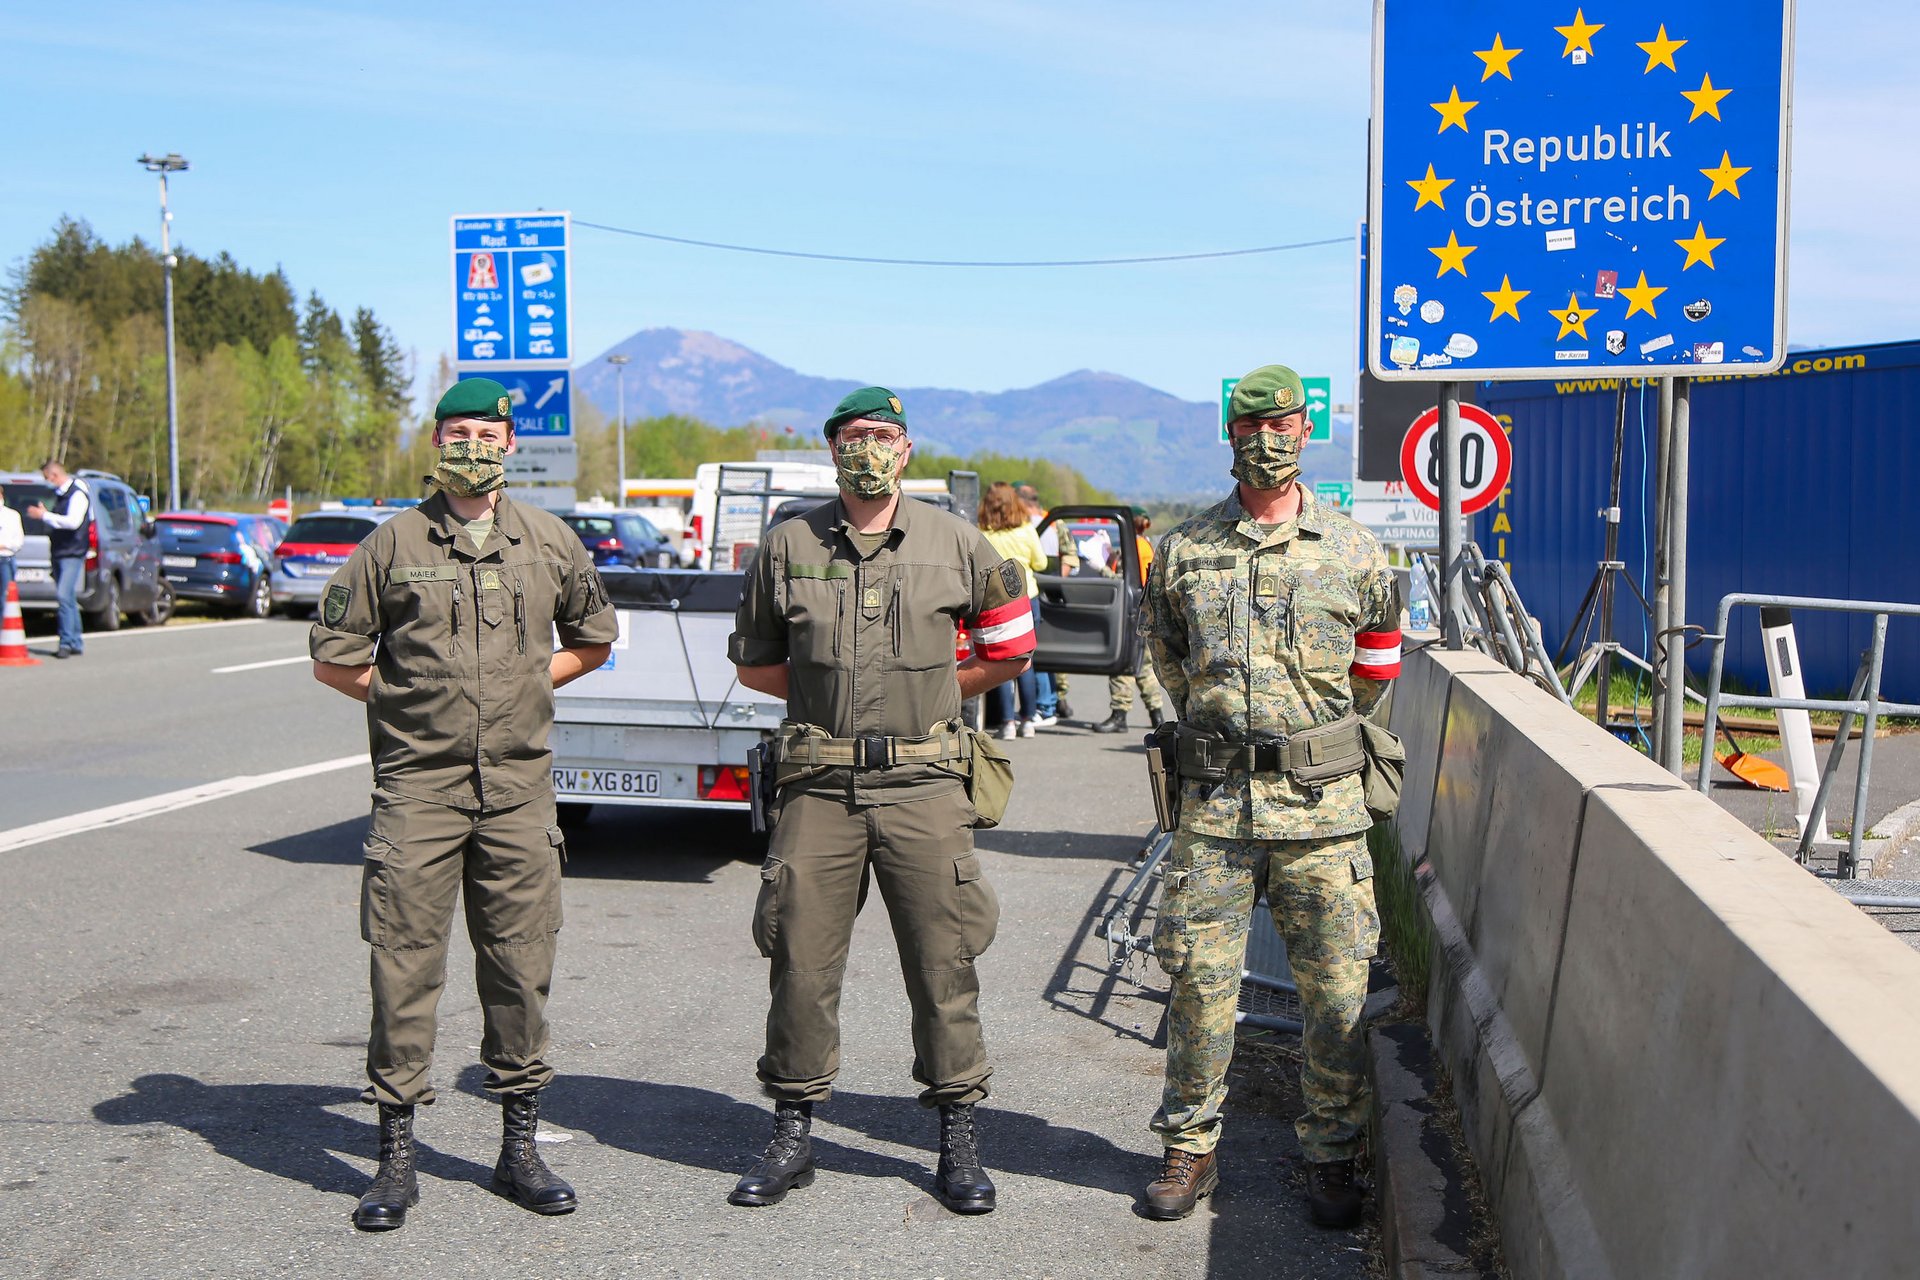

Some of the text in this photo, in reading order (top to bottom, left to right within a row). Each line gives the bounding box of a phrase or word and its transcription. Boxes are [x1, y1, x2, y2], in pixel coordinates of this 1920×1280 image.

[1484, 122, 1672, 172] Republik
[1465, 185, 1690, 228] Österreich
[514, 416, 544, 431] SALE
[1383, 527, 1435, 539] ASFINAG
[410, 570, 437, 578] MAIER
[552, 769, 658, 793] RW XG 810
